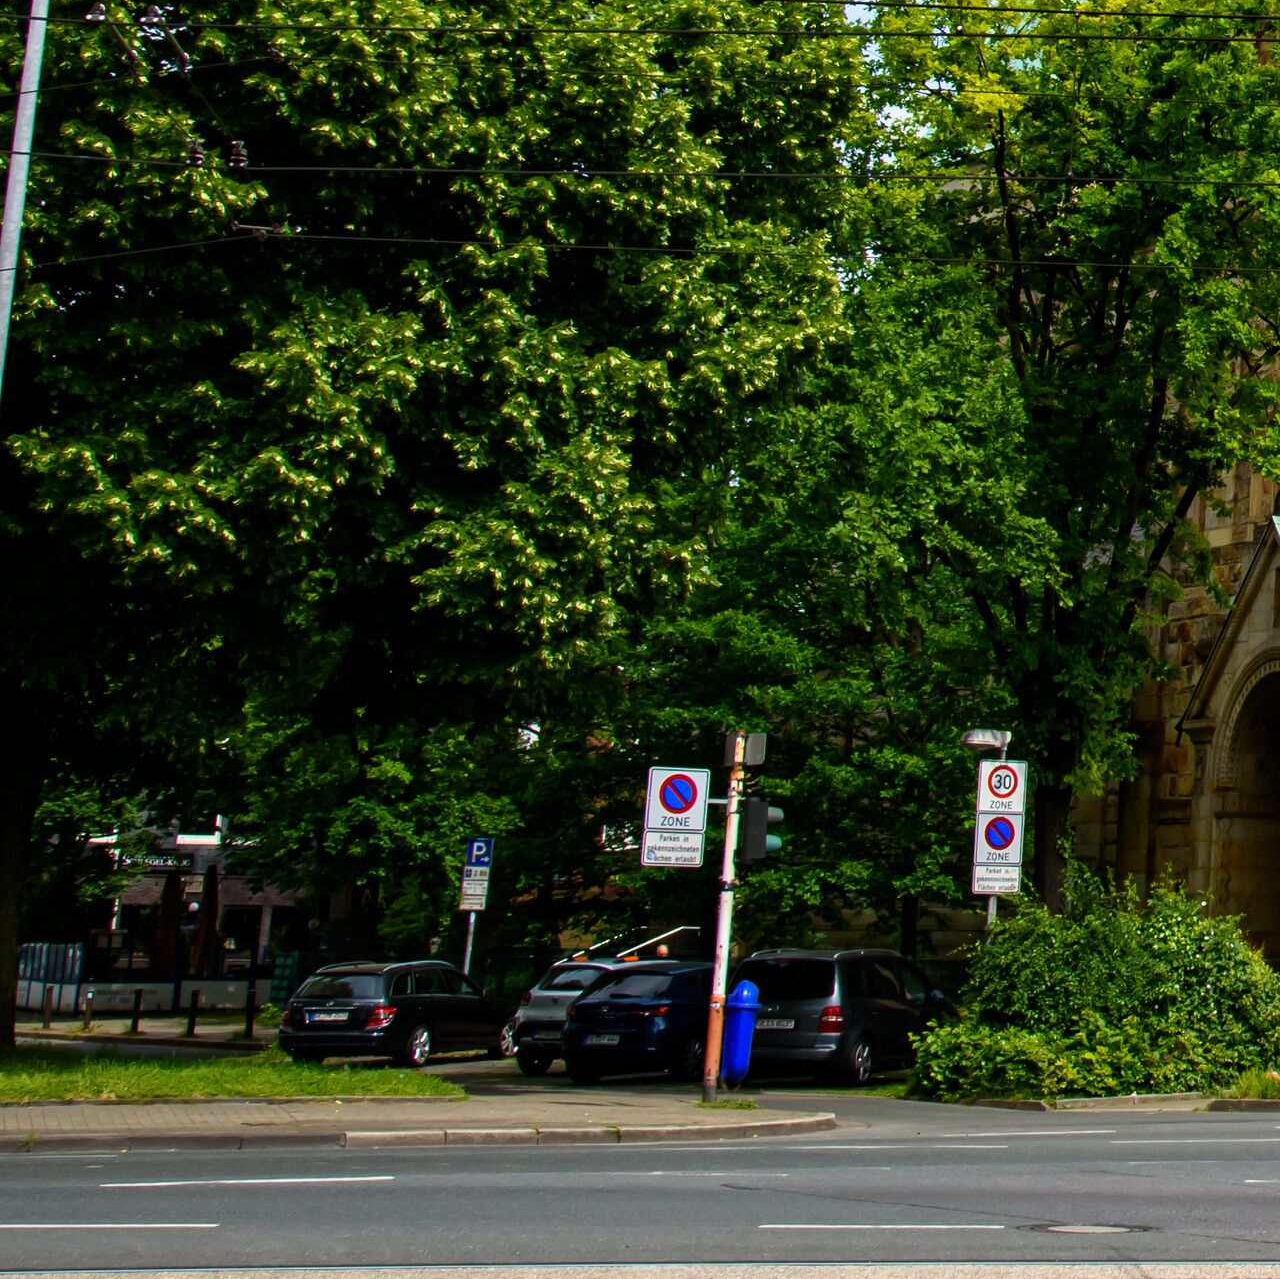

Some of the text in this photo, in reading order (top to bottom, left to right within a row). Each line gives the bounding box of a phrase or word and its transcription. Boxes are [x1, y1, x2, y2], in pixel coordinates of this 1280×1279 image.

[994, 774, 1012, 789] 30
[990, 800, 1013, 809] ZONE
[660, 816, 691, 827] ZONE
[471, 842, 487, 862] P
[986, 852, 1010, 861] ZONE
